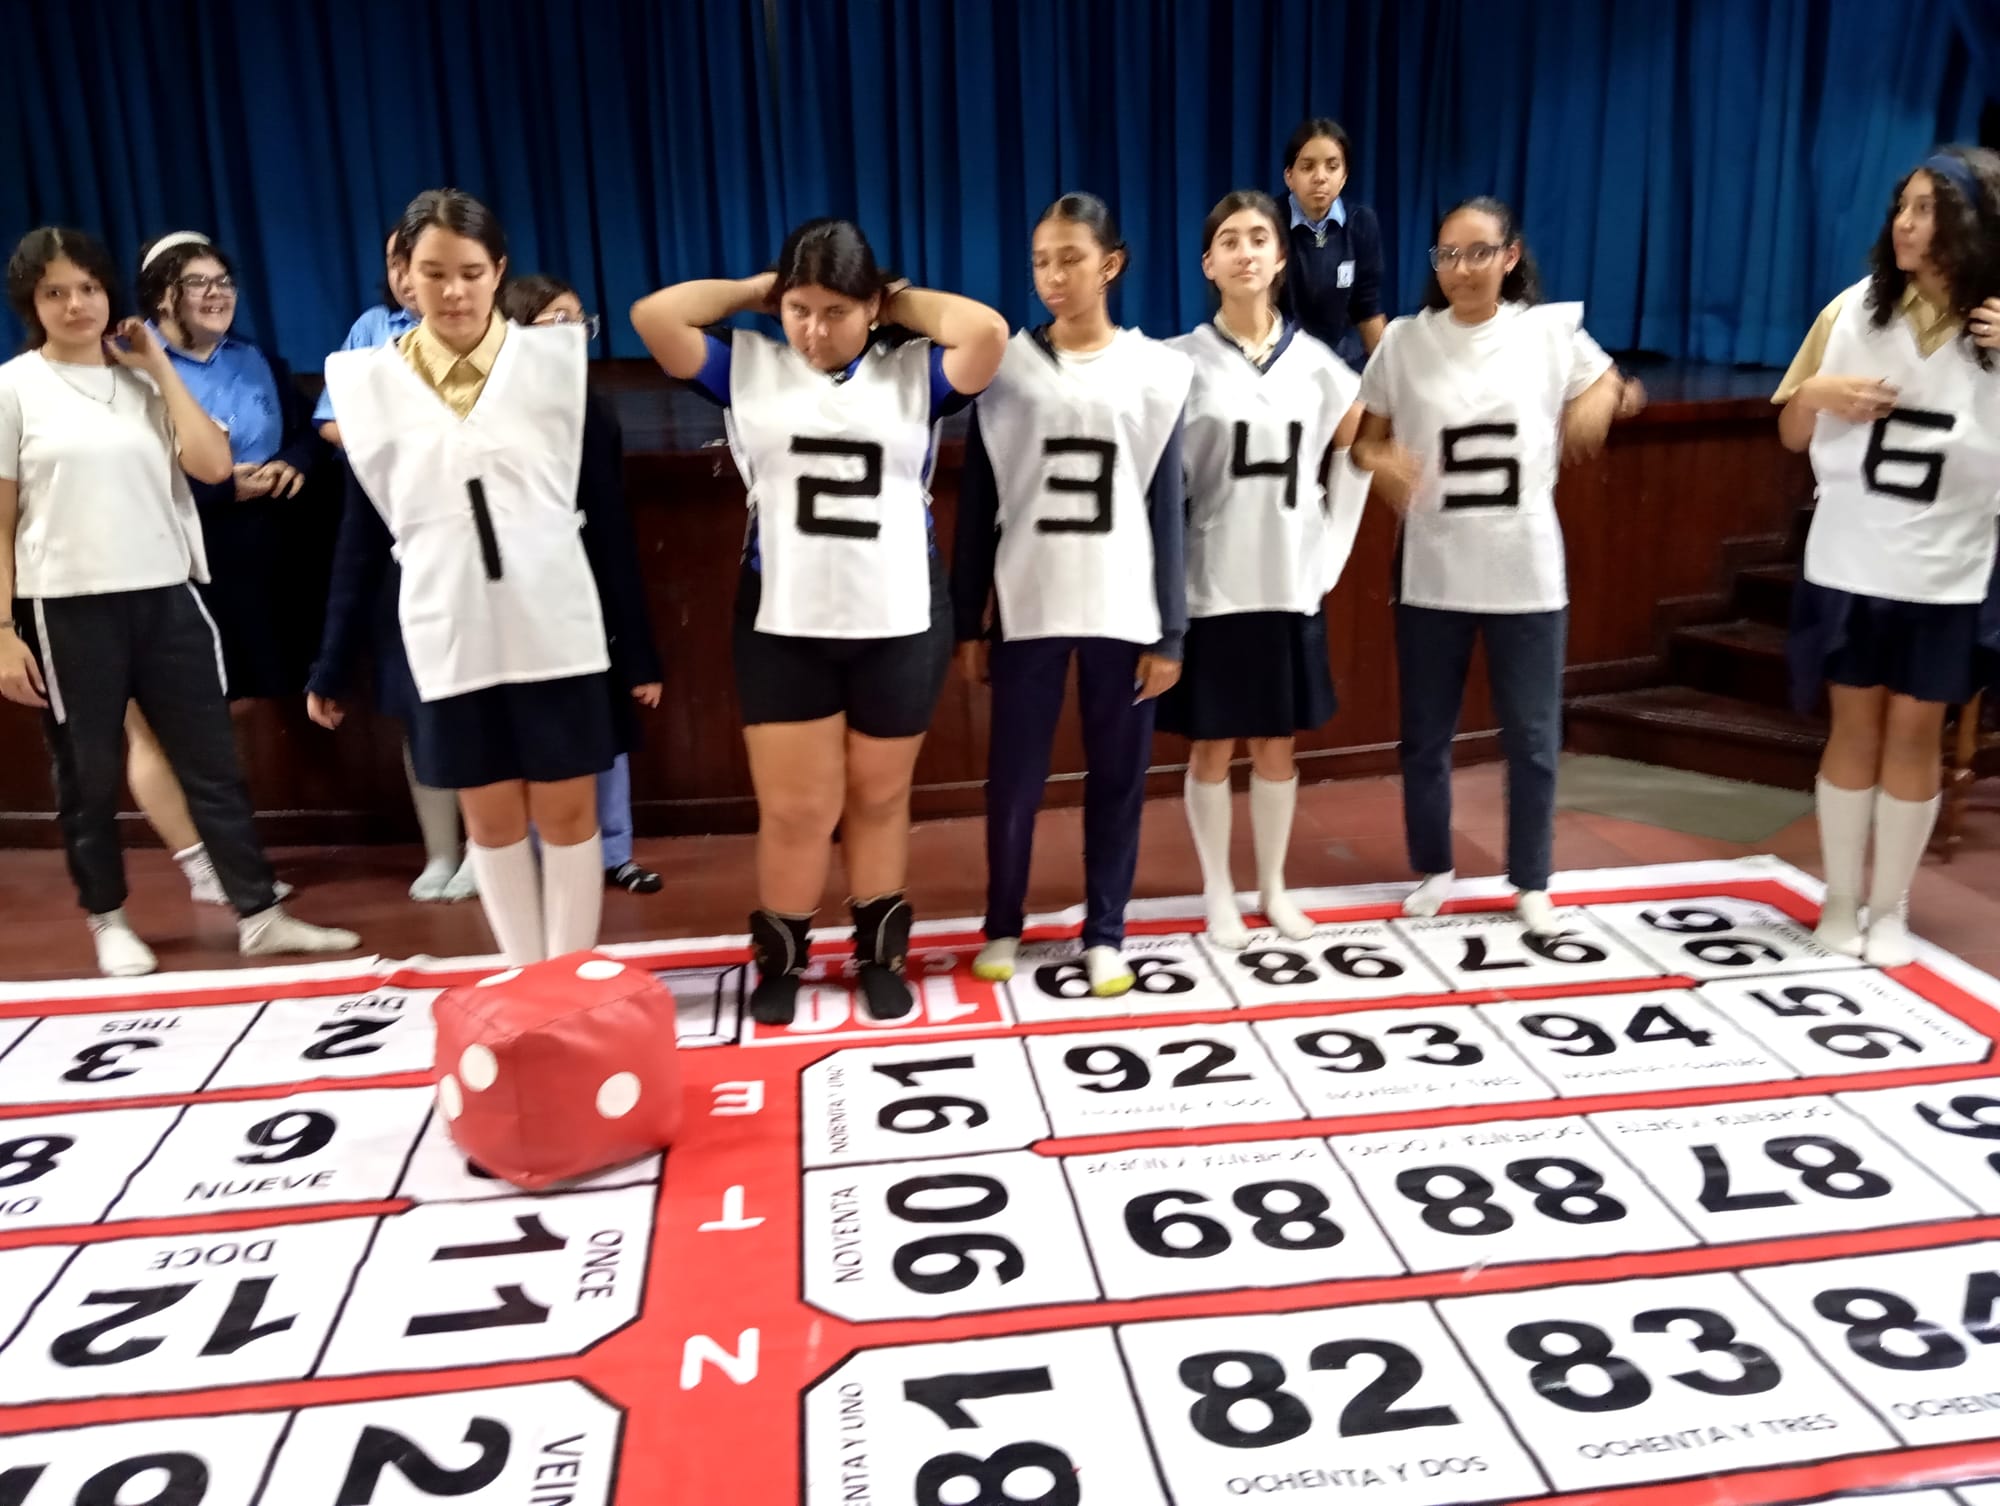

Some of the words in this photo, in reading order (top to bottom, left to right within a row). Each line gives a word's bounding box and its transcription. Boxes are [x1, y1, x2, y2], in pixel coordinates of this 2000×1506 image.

[790, 435, 884, 540] 2
[1035, 435, 1118, 535] 3
[1229, 420, 1303, 509] 4
[1440, 421, 1521, 512] 5
[1861, 400, 1957, 506] 6
[466, 478, 503, 582] 1
[61, 1038, 162, 1084] 3
[301, 1016, 404, 1061] 2
[1293, 1022, 1486, 1074] 93
[1518, 1003, 1716, 1058] 94
[1746, 985, 1924, 1060] 95
[871, 1054, 990, 1135] 91
[1063, 1038, 1254, 1094] 92
[235, 1110, 339, 1166] 9
[1690, 1134, 1893, 1214] 87
[185, 1169, 338, 1202] NUEVE
[1395, 1156, 1628, 1237] 88
[148, 1238, 278, 1270] DOCE
[575, 1228, 624, 1302] ONCE
[831, 1184, 864, 1283] NOVENTA
[885, 1172, 1026, 1296] 90
[400, 1211, 569, 1338] 11
[48, 1274, 300, 1369] 12
[1505, 1307, 1783, 1414] 83
[838, 1382, 866, 1432] UNO
[1177, 1338, 1462, 1450] 82
[902, 1364, 1081, 1506] 81
[1226, 1467, 1385, 1495] OCHENTA
[1389, 1463, 1409, 1483] Y
[1419, 1455, 1489, 1480] DOS
[1577, 1426, 1733, 1460] OCHENTA
[1733, 1421, 1759, 1440] Y
[1760, 1412, 1838, 1434] TRES
